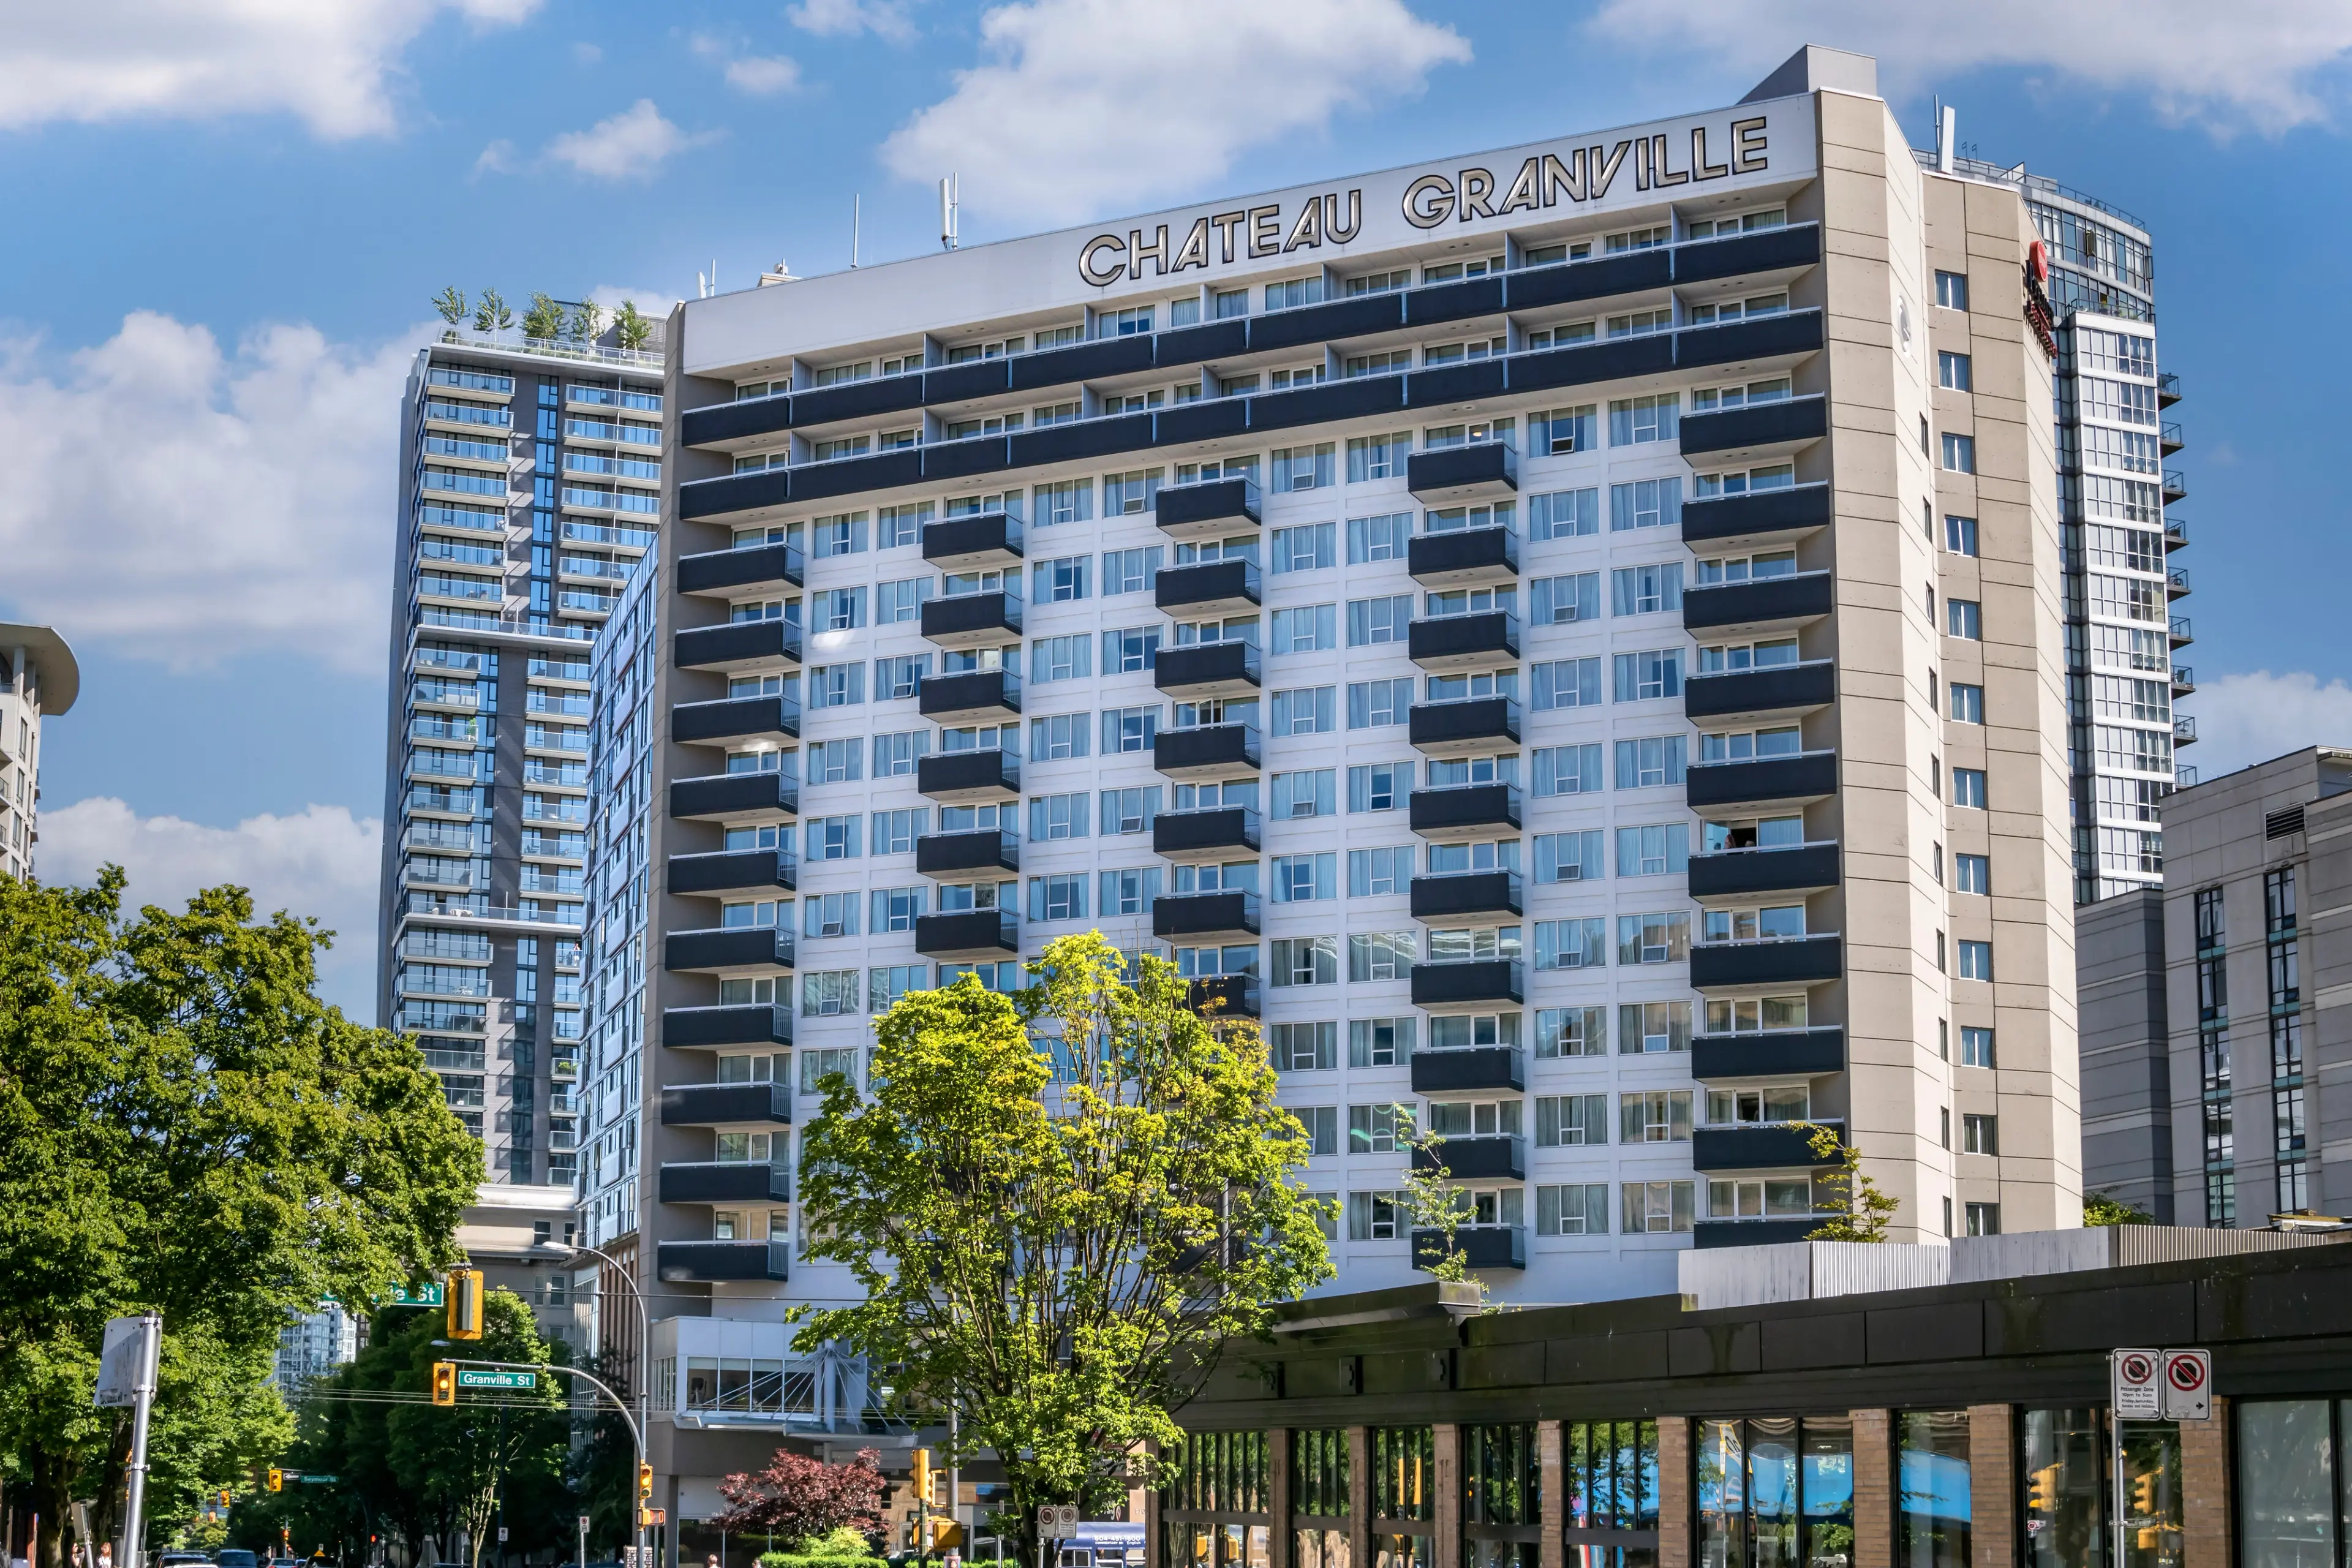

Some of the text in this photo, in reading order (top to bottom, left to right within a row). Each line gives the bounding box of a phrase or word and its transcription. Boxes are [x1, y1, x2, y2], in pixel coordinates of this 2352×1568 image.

[1078, 115, 1768, 287] CHATEAU GRANVILLE
[464, 1373, 530, 1385] Granville St
